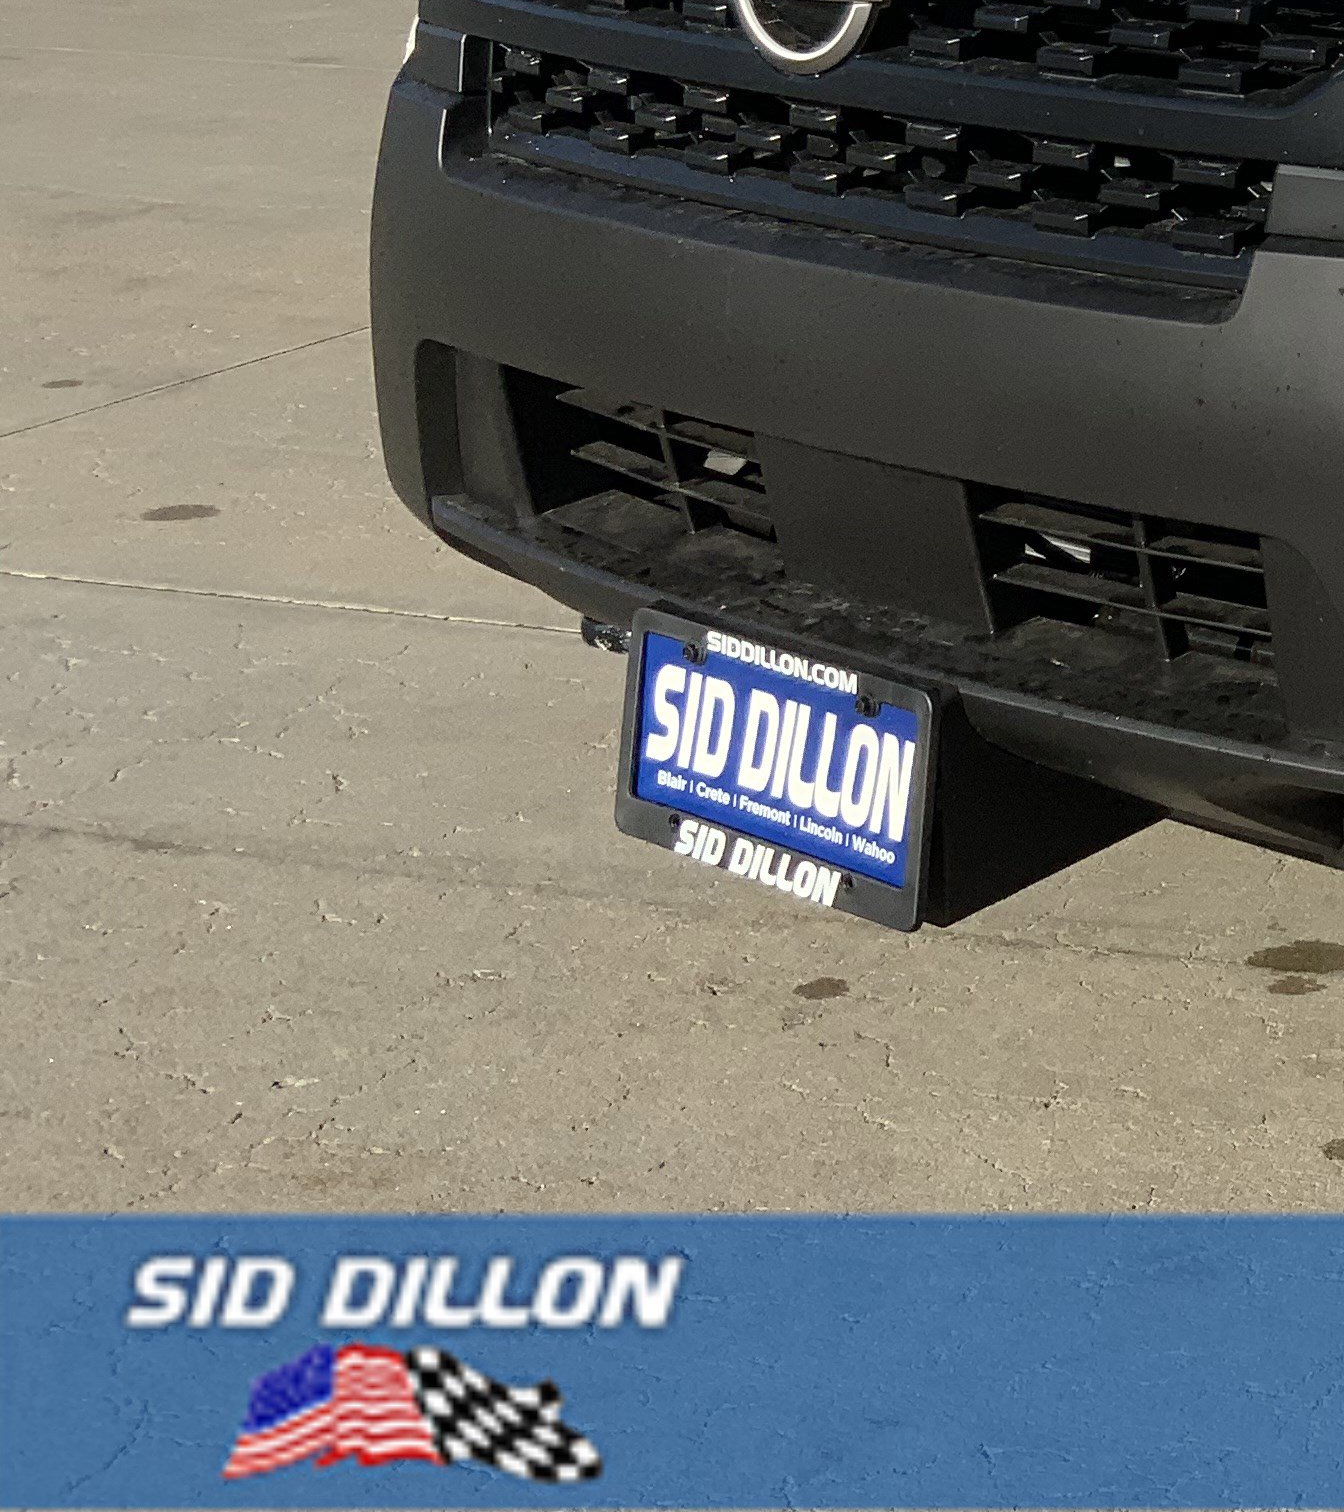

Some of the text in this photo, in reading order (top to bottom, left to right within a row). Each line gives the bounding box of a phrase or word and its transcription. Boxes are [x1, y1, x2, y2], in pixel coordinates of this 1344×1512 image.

[707, 631, 858, 694] SIDDILLON.COM
[645, 664, 915, 842] SID DILLON
[657, 770, 896, 865] Blair Crete Fremont Lincoln Wahoo
[674, 820, 841, 907] SID DILLON
